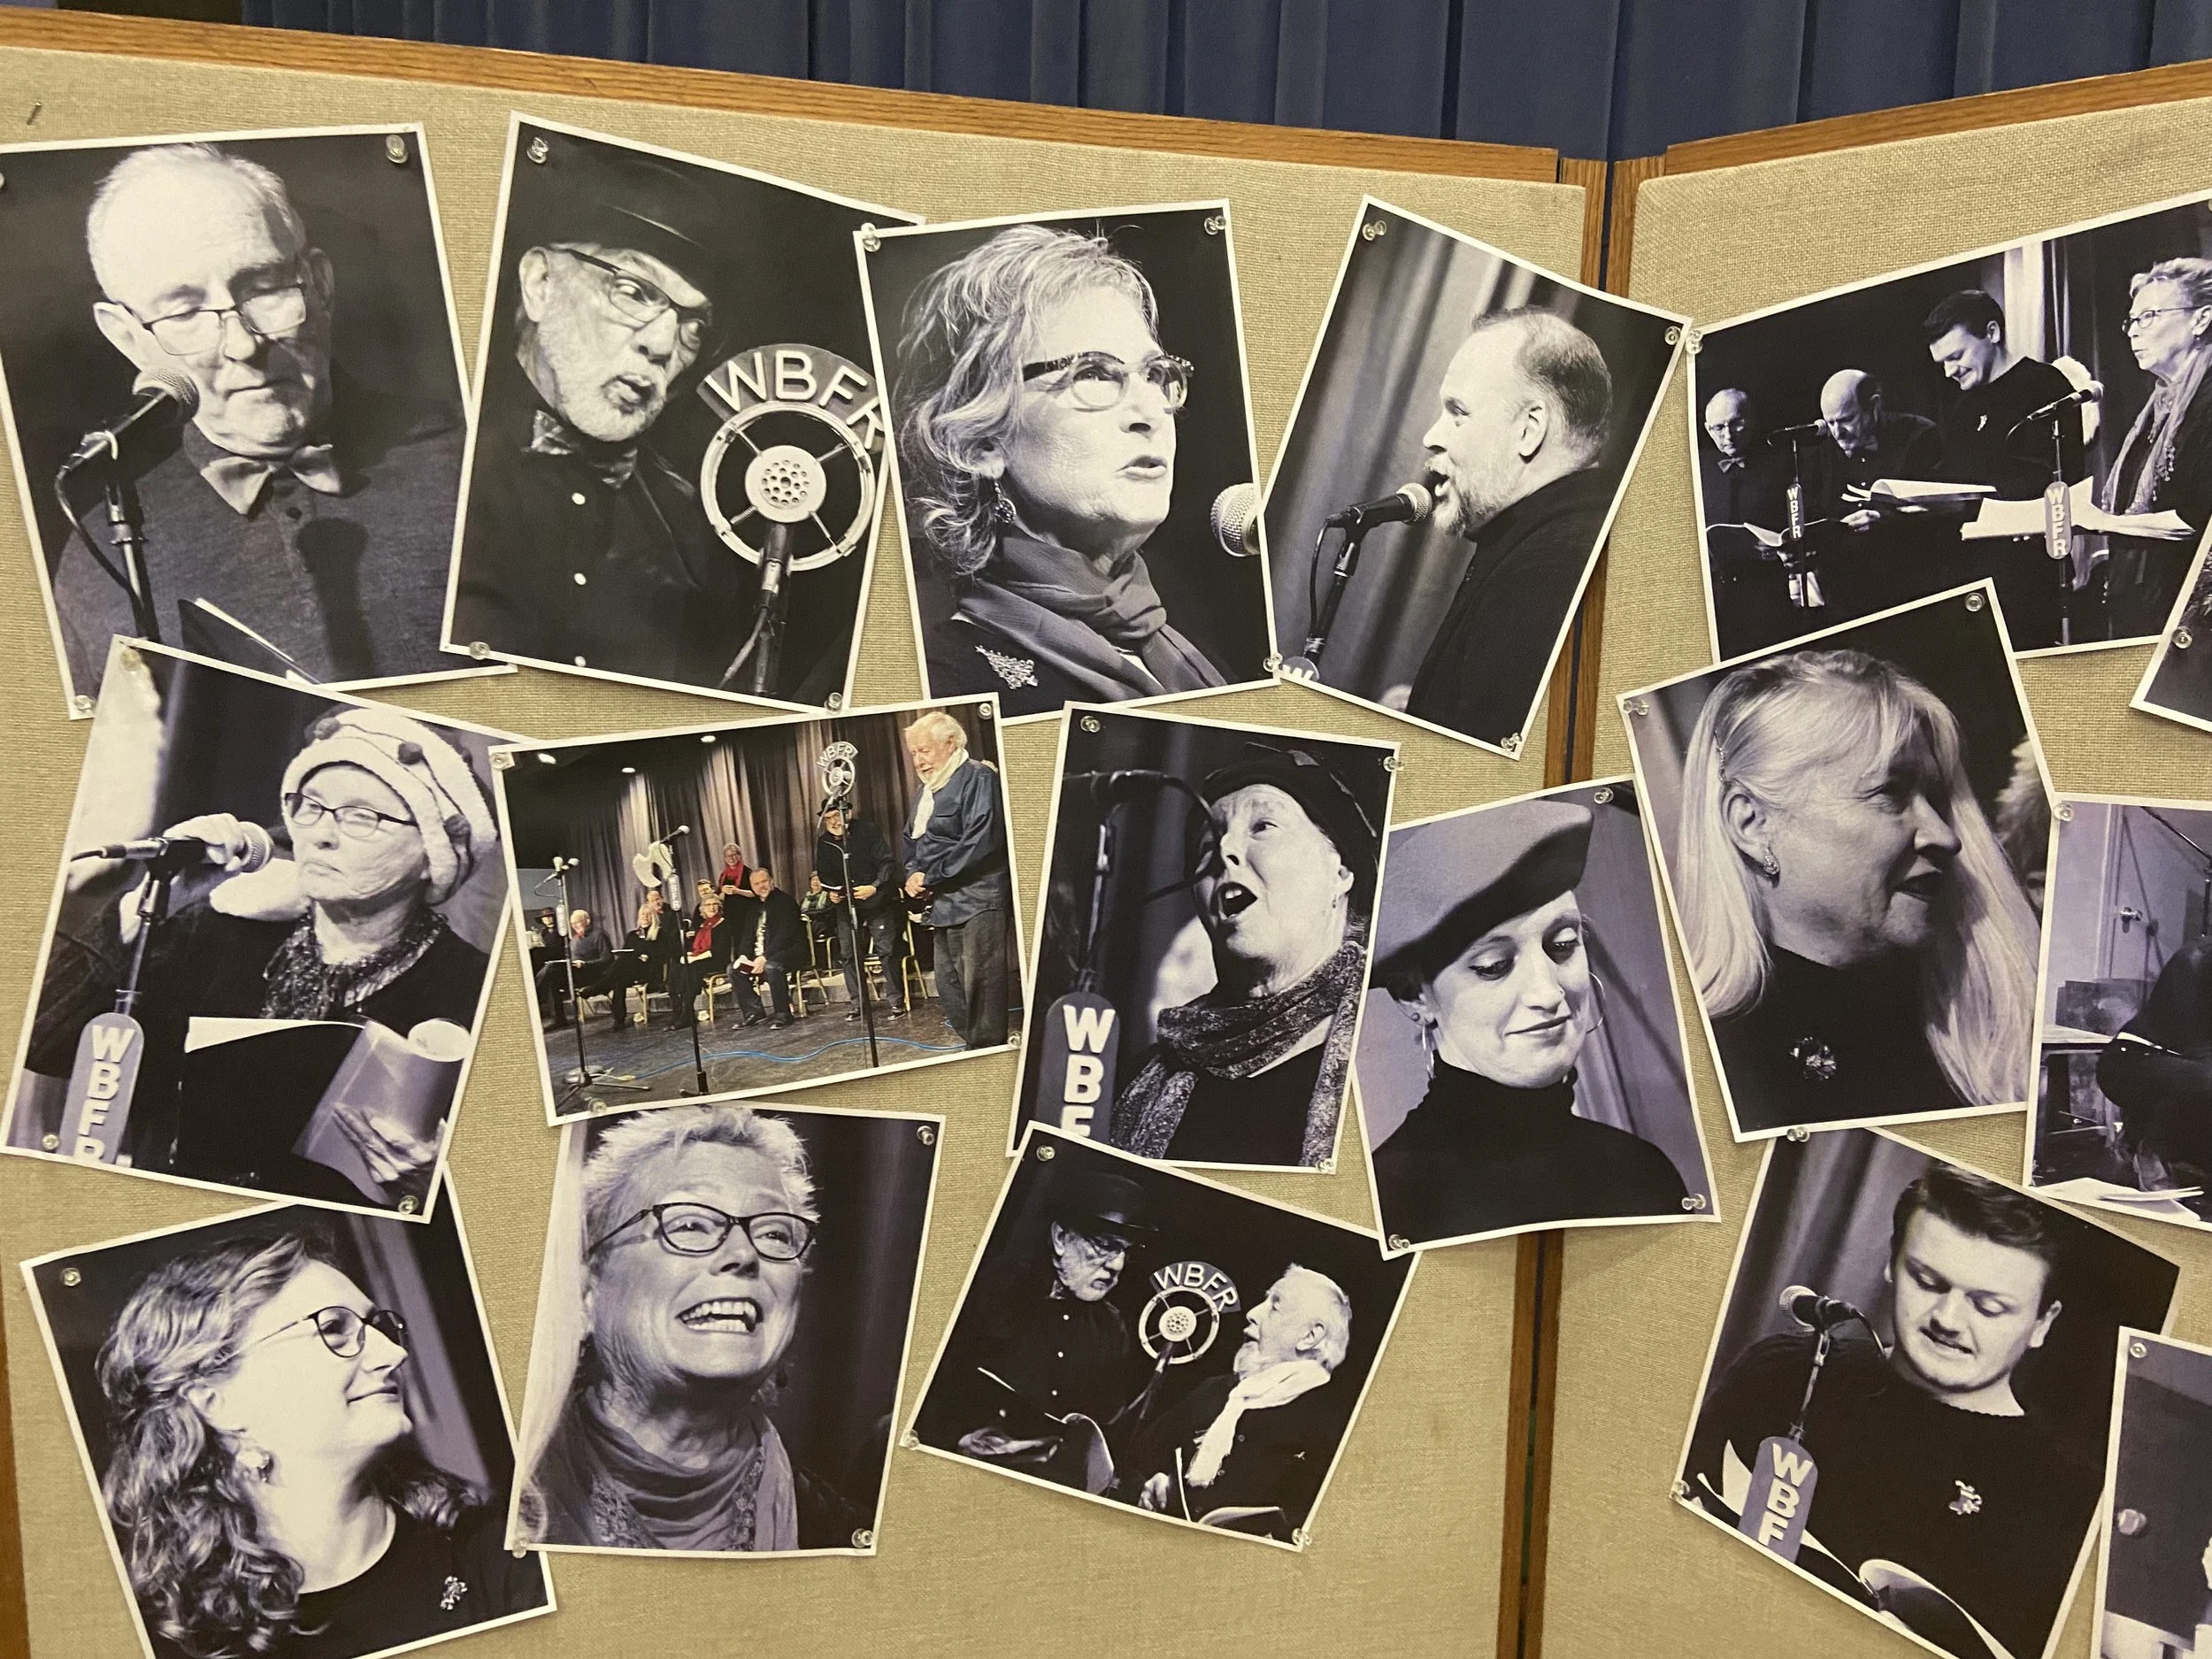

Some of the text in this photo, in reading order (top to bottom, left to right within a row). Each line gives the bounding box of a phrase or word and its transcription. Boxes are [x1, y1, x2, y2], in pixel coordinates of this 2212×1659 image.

[1787, 487, 1802, 538] WBFR
[2047, 487, 2067, 557] WBFR
[816, 743, 854, 768] WBFR
[1154, 1263, 1238, 1312] WBFR
[1757, 1443, 1814, 1547] WBF
